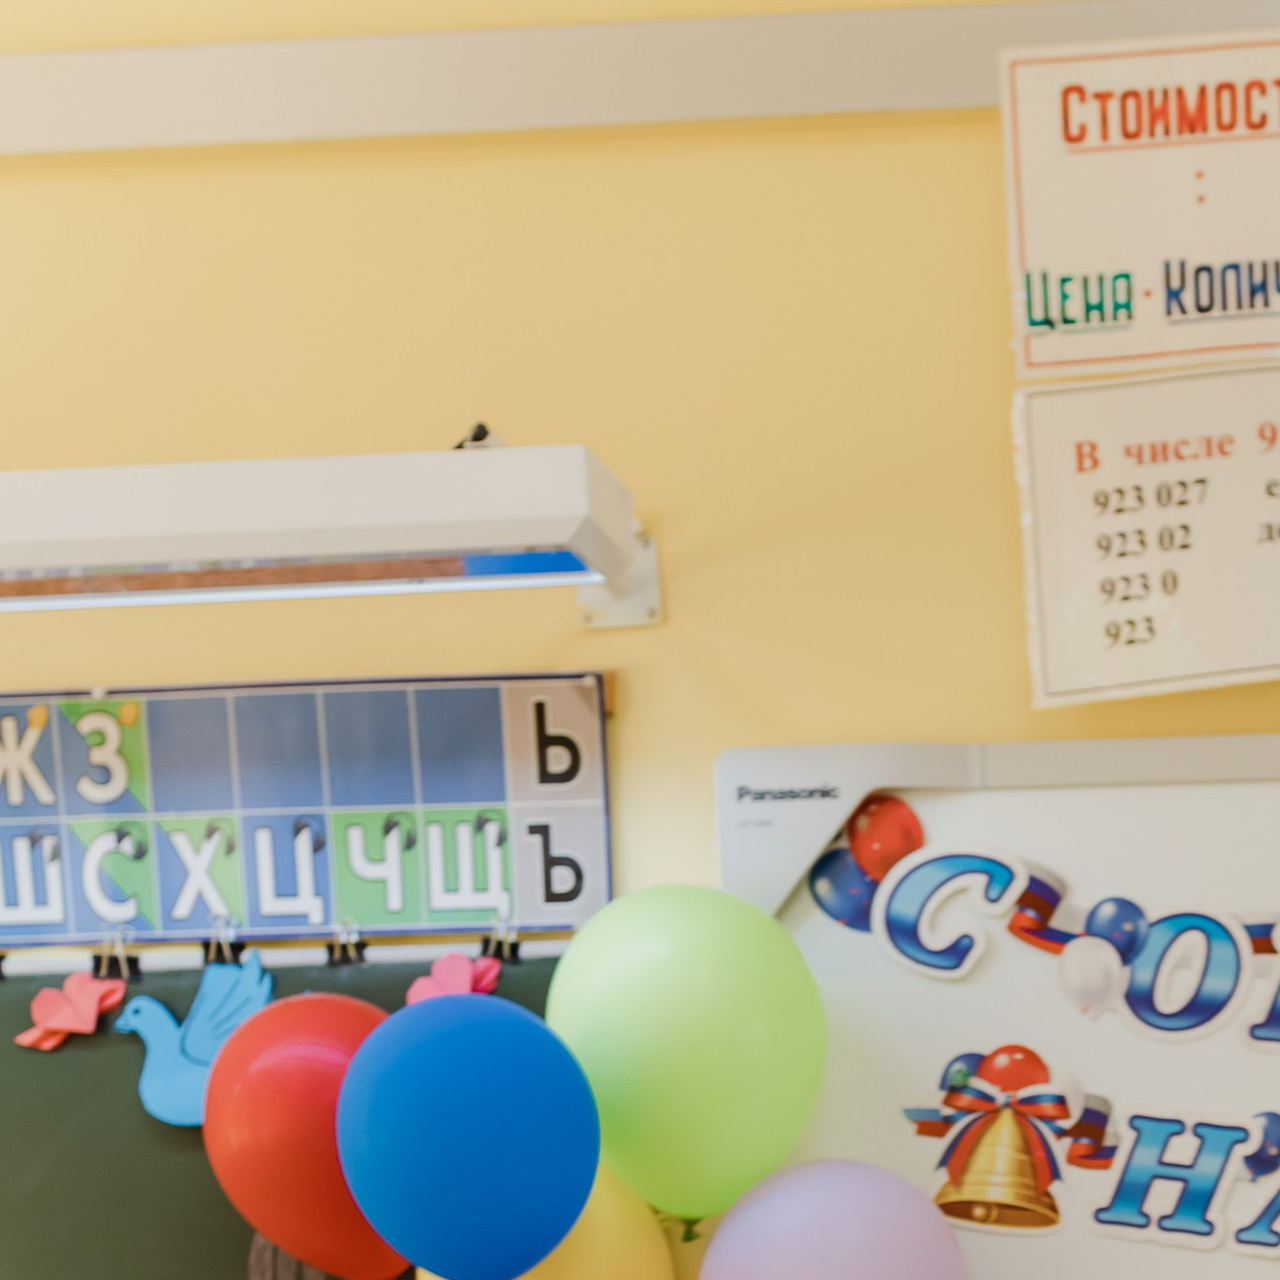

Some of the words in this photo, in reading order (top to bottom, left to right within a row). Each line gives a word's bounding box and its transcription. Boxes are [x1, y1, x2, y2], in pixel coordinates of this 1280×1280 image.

[1075, 440, 1101, 474] В
[1124, 432, 1236, 468] числе
[1093, 485, 1146, 517] 923
[1156, 478, 1209, 508] 027
[1096, 530, 1149, 560] 923
[1158, 523, 1194, 552] 02
[1100, 574, 1152, 604] 923
[1161, 569, 1179, 598] 0
[1104, 617, 1156, 649] 923
[0, 706, 57, 807] Ж
[534, 701, 582, 785] Ь
[737, 784, 839, 802] Panasonic
[0, 834, 65, 925] Ш
[81, 829, 139, 923] С
[169, 827, 226, 920] Х
[254, 826, 325, 925] Ц
[346, 824, 404, 914] Ч
[425, 821, 510, 922] Щ
[527, 824, 584, 903] Ъ
[886, 853, 1015, 972] С
